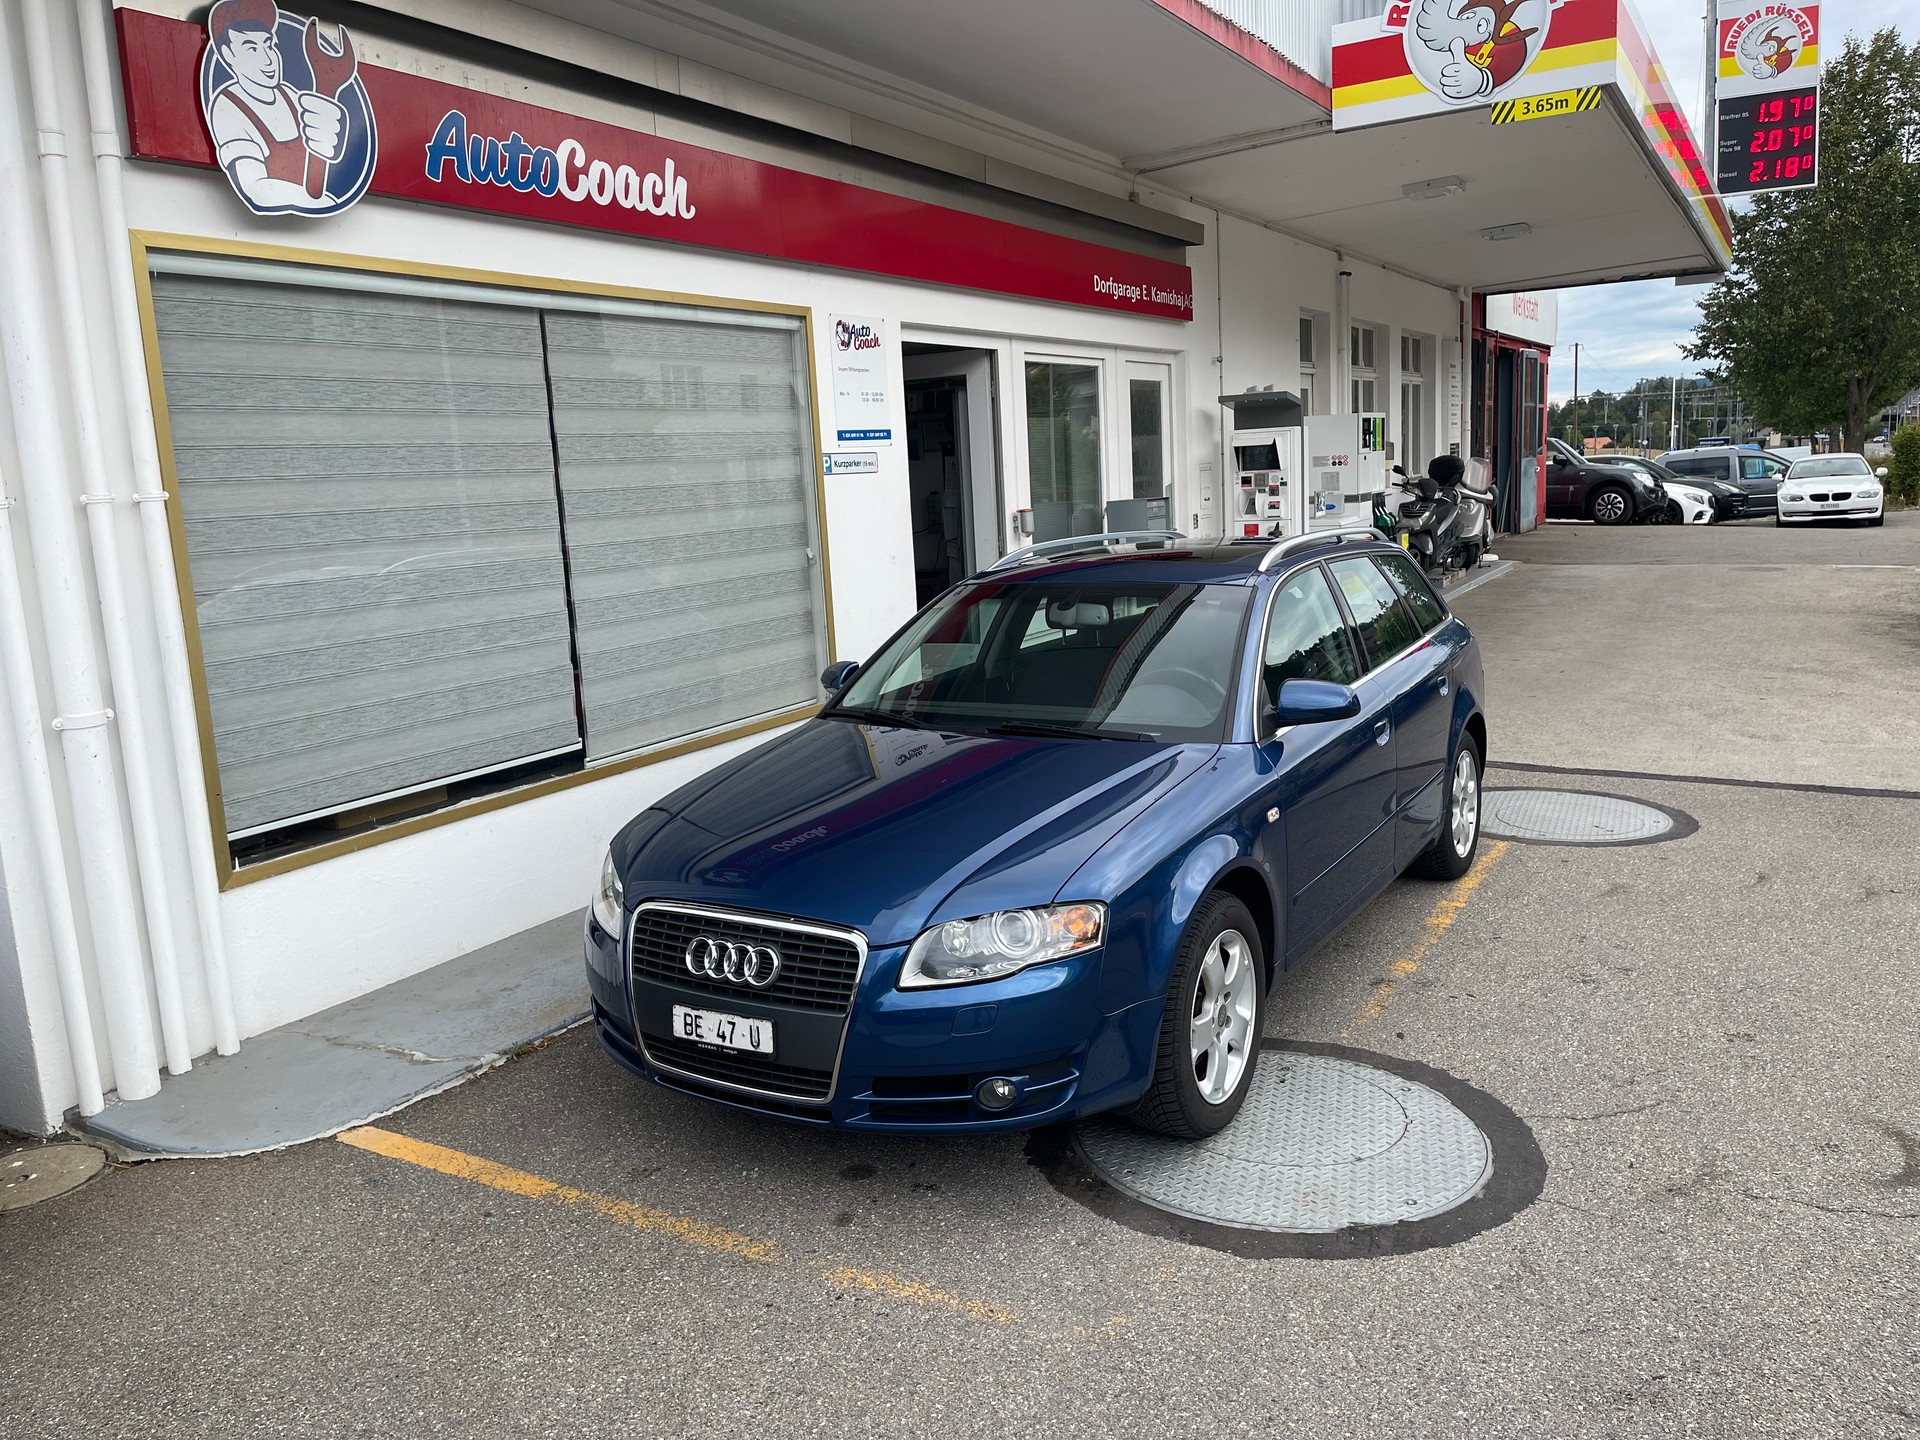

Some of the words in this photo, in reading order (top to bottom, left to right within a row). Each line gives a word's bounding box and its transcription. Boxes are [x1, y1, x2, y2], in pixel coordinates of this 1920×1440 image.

[1727, 9, 1762, 50] RUEDI
[1765, 3, 1814, 41] RÜSSEL
[1521, 96, 1569, 116] 3.65m
[1720, 113, 1742, 121] Bleifrei
[1742, 111, 1749, 119] 95
[425, 109, 696, 220] AutoCoach
[1719, 171, 1738, 179] Diesel
[1093, 274, 1141, 303] Dorfgarage
[1142, 284, 1150, 301] E.
[1151, 286, 1184, 311] Kamishaj
[1512, 292, 1539, 323] Werkstatt
[850, 323, 871, 338] Auto
[853, 333, 881, 351] Coach
[834, 459, 861, 469] Kurzparker
[683, 1012, 705, 1039] BE
[716, 1019, 737, 1045] 47
[749, 1024, 761, 1050] U
